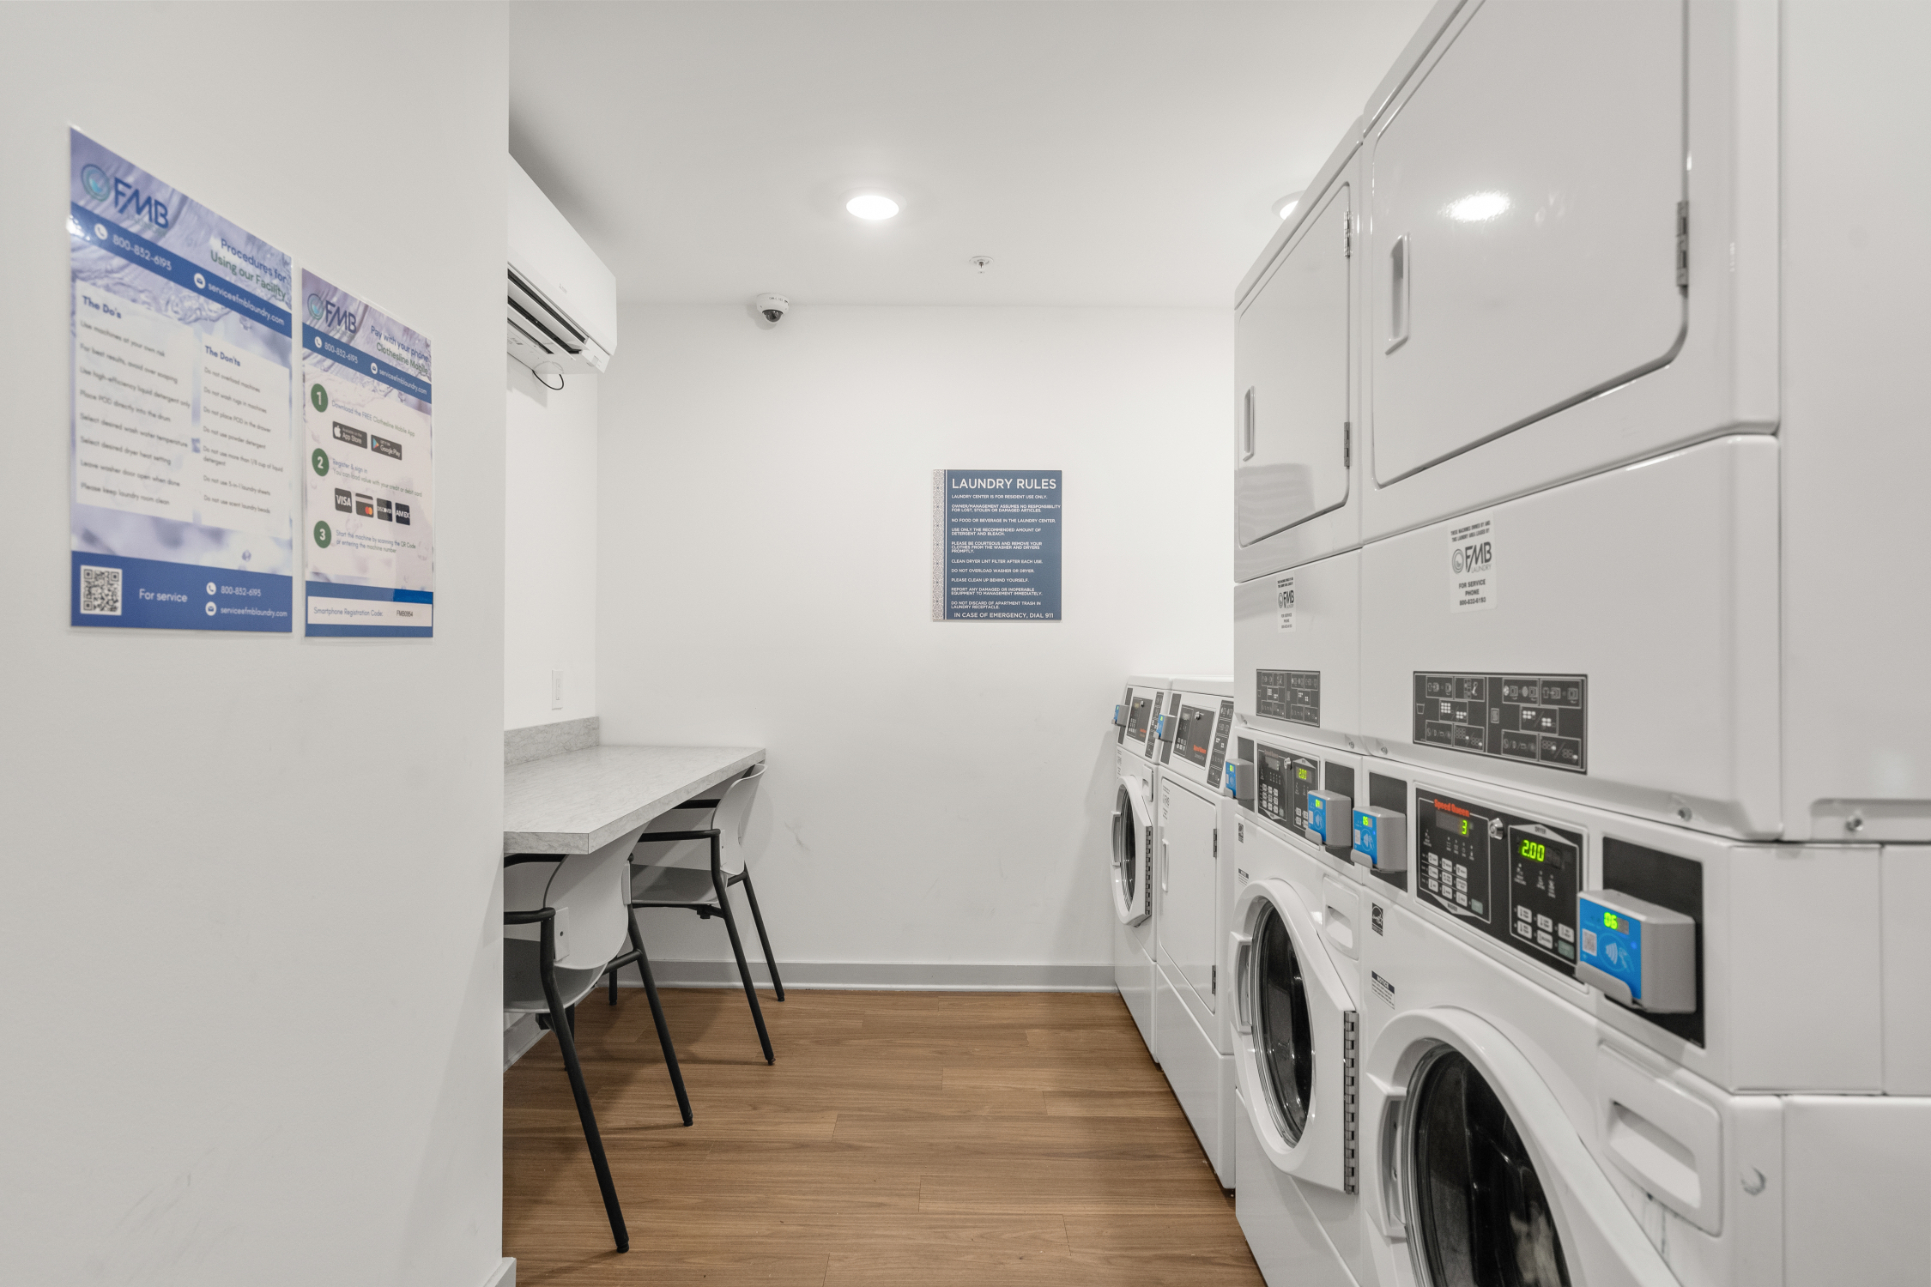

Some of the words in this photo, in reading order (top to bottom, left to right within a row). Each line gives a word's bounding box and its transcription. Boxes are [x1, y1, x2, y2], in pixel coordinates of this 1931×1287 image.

[114, 178, 168, 228] FMB
[221, 238, 273, 277] Procedures
[274, 267, 286, 285] for
[210, 250, 237, 277] Using
[238, 266, 254, 282] our
[256, 274, 286, 303] Facility
[82, 295, 100, 312] The
[103, 303, 122, 320] Do's
[325, 300, 356, 334] FMB
[205, 345, 218, 358] The
[220, 351, 241, 367] Don'ts
[342, 432, 351, 442] App
[351, 435, 362, 445] Store
[317, 456, 324, 470] 2
[952, 478, 1012, 489] LAUNDRY
[1017, 478, 1056, 489] RULES
[336, 495, 352, 507] VISA
[319, 528, 326, 541] 3
[1465, 542, 1492, 572] FMB
[1468, 579, 1486, 588] SERVICE
[139, 589, 155, 601] For
[157, 590, 188, 603] service
[314, 607, 343, 616] Smartphone
[344, 609, 370, 618] Registration
[371, 610, 384, 618] Code:
[1462, 820, 1468, 835] 3
[1522, 840, 1545, 862] 2.00
